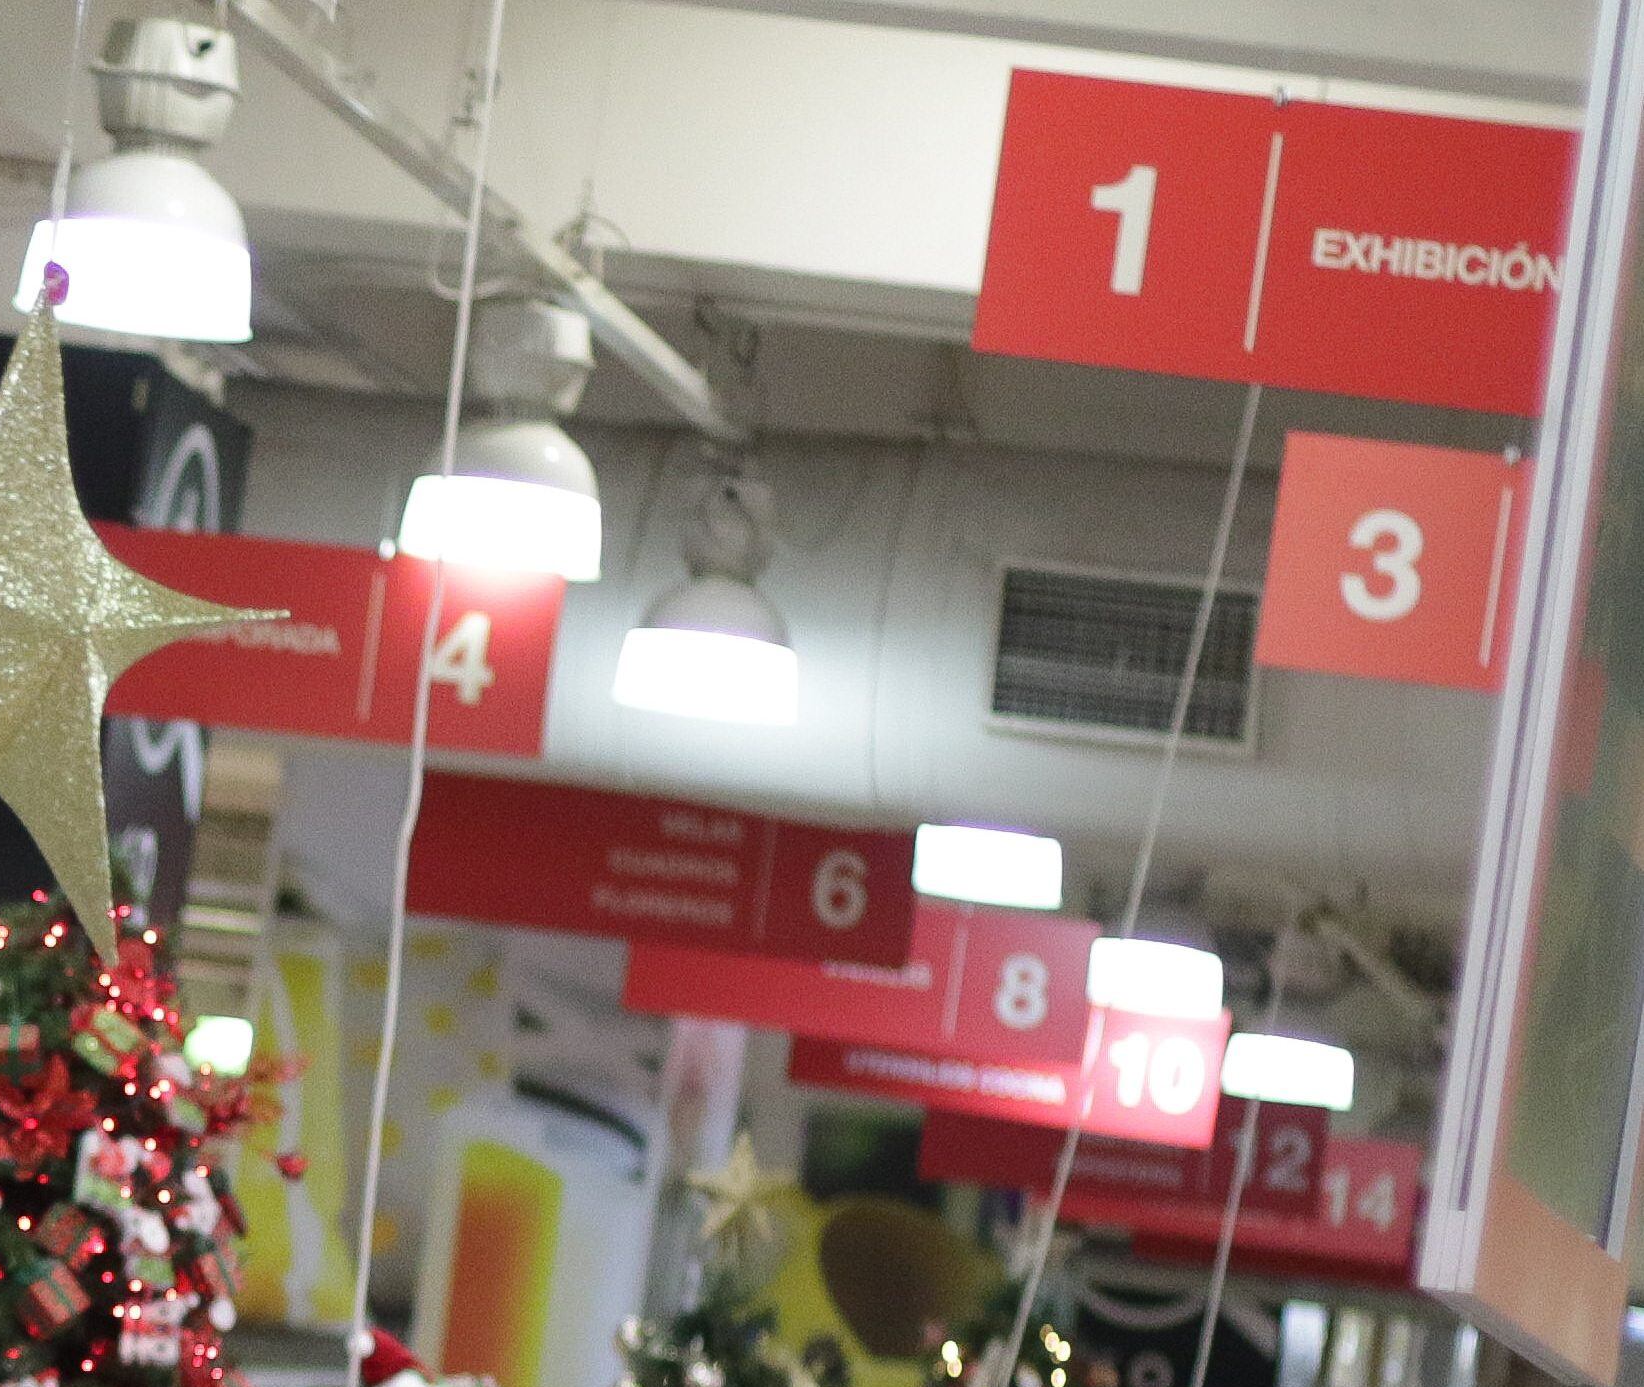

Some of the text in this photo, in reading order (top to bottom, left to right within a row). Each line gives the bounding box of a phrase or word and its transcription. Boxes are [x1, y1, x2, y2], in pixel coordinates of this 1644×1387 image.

[1090, 165, 1158, 297] 1
[1311, 227, 1567, 293] EXHIBICIÓN
[1341, 509, 1422, 622] 3
[431, 612, 494, 706] 4
[810, 847, 869, 930] 6
[993, 954, 1049, 1031] 8
[1109, 1034, 1205, 1114] 10
[1228, 1126, 1311, 1192] 12
[1325, 1166, 1395, 1231] 14
